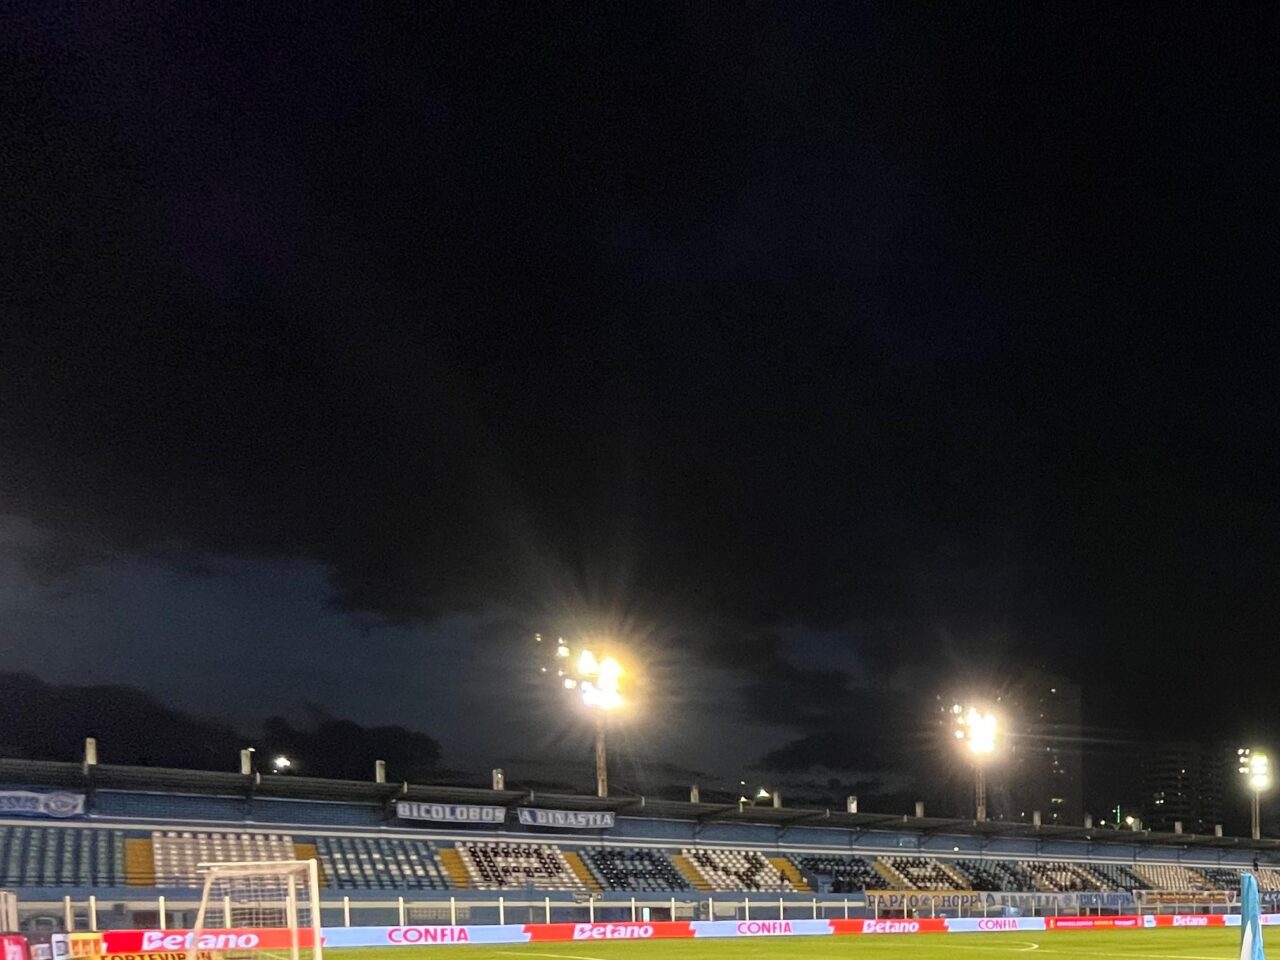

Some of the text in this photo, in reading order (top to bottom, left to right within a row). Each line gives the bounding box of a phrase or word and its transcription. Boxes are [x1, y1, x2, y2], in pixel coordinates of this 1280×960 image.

[398, 802, 505, 823] BICOLOBOS
[537, 811, 612, 827] DINASTIA
[573, 923, 654, 940] Betano
[736, 922, 793, 935] CONFIA
[862, 920, 920, 934] Betano
[978, 919, 1017, 930] CONFIA
[141, 931, 259, 951] Betano
[388, 927, 470, 943] CONFIA
